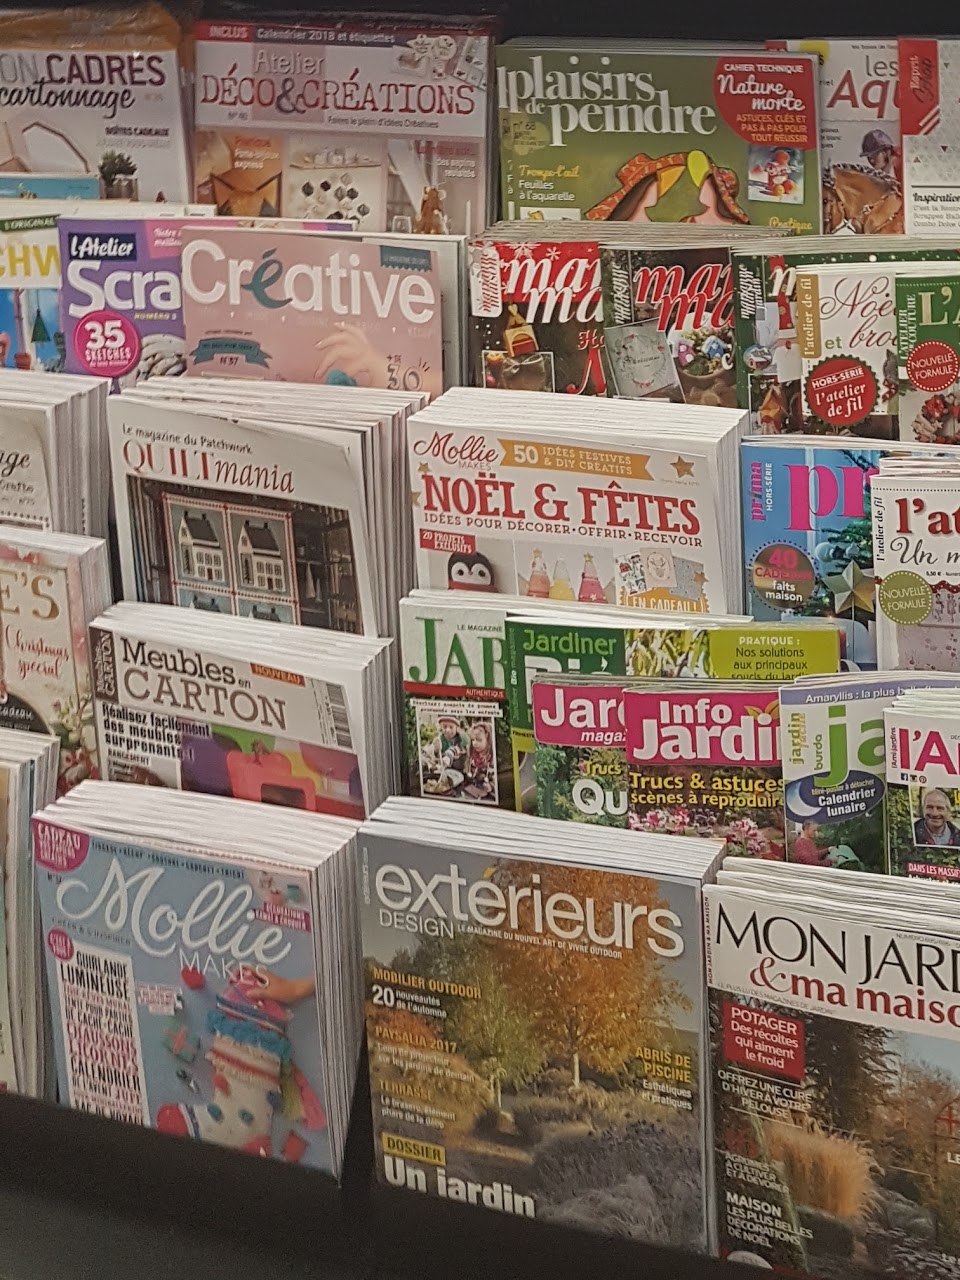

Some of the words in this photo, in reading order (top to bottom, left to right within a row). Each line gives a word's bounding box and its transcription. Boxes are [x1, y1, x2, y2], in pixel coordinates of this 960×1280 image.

[209, 27, 248, 38] INCLUS
[257, 30, 306, 42] Calendrier
[349, 32, 395, 44] étiquettes
[46, 55, 166, 86] CADRES
[254, 51, 325, 74] Atelier
[724, 64, 754, 72] CAHIER
[757, 64, 804, 73] TECHNIQUE
[507, 56, 656, 112] plaisirs
[718, 74, 787, 96] Nature
[752, 96, 806, 111] morte
[525, 101, 545, 114] de
[551, 91, 717, 146] peindre
[519, 181, 553, 190] Feuilles
[520, 191, 526, 200] à
[529, 191, 575, 201] l'aquarelle
[182, 239, 435, 324] Créative
[85, 320, 126, 349] 35
[912, 356, 953, 370] NOUVELLE
[915, 365, 953, 380] FORMULE
[812, 367, 863, 390] HORS-SÉRIE
[816, 385, 866, 405] l'atelier
[828, 401, 844, 417] de
[846, 398, 862, 411] fil
[414, 432, 499, 464] Mollie
[514, 447, 538, 465] 50
[543, 447, 576, 459] IDÉES
[579, 450, 632, 465] FESTIVES
[421, 473, 526, 519] NOËL
[578, 481, 700, 535] FÊTES
[765, 591, 802, 601] maison
[772, 581, 795, 592] faits
[884, 586, 926, 600] NOUVELLE
[887, 597, 927, 610] FORMULE
[523, 630, 615, 654] Jardiner
[758, 646, 804, 658] solutions
[122, 637, 235, 683] Meubles
[239, 678, 251, 688] en
[755, 660, 807, 672] principaux
[253, 664, 301, 685] NOUVEAU
[124, 670, 286, 730] CARTON
[818, 785, 876, 806] Calendrier
[826, 799, 867, 817] lunaire
[56, 857, 290, 964] Mollie
[375, 863, 684, 958] extérieurs
[380, 910, 454, 939] DESIGN
[716, 903, 846, 973] MON
[180, 949, 269, 988] MAKES
[373, 969, 426, 990] MOBILIER
[429, 979, 481, 999] OUTDOOR
[791, 975, 847, 1007] ma
[731, 1007, 797, 1036] POTAGER
